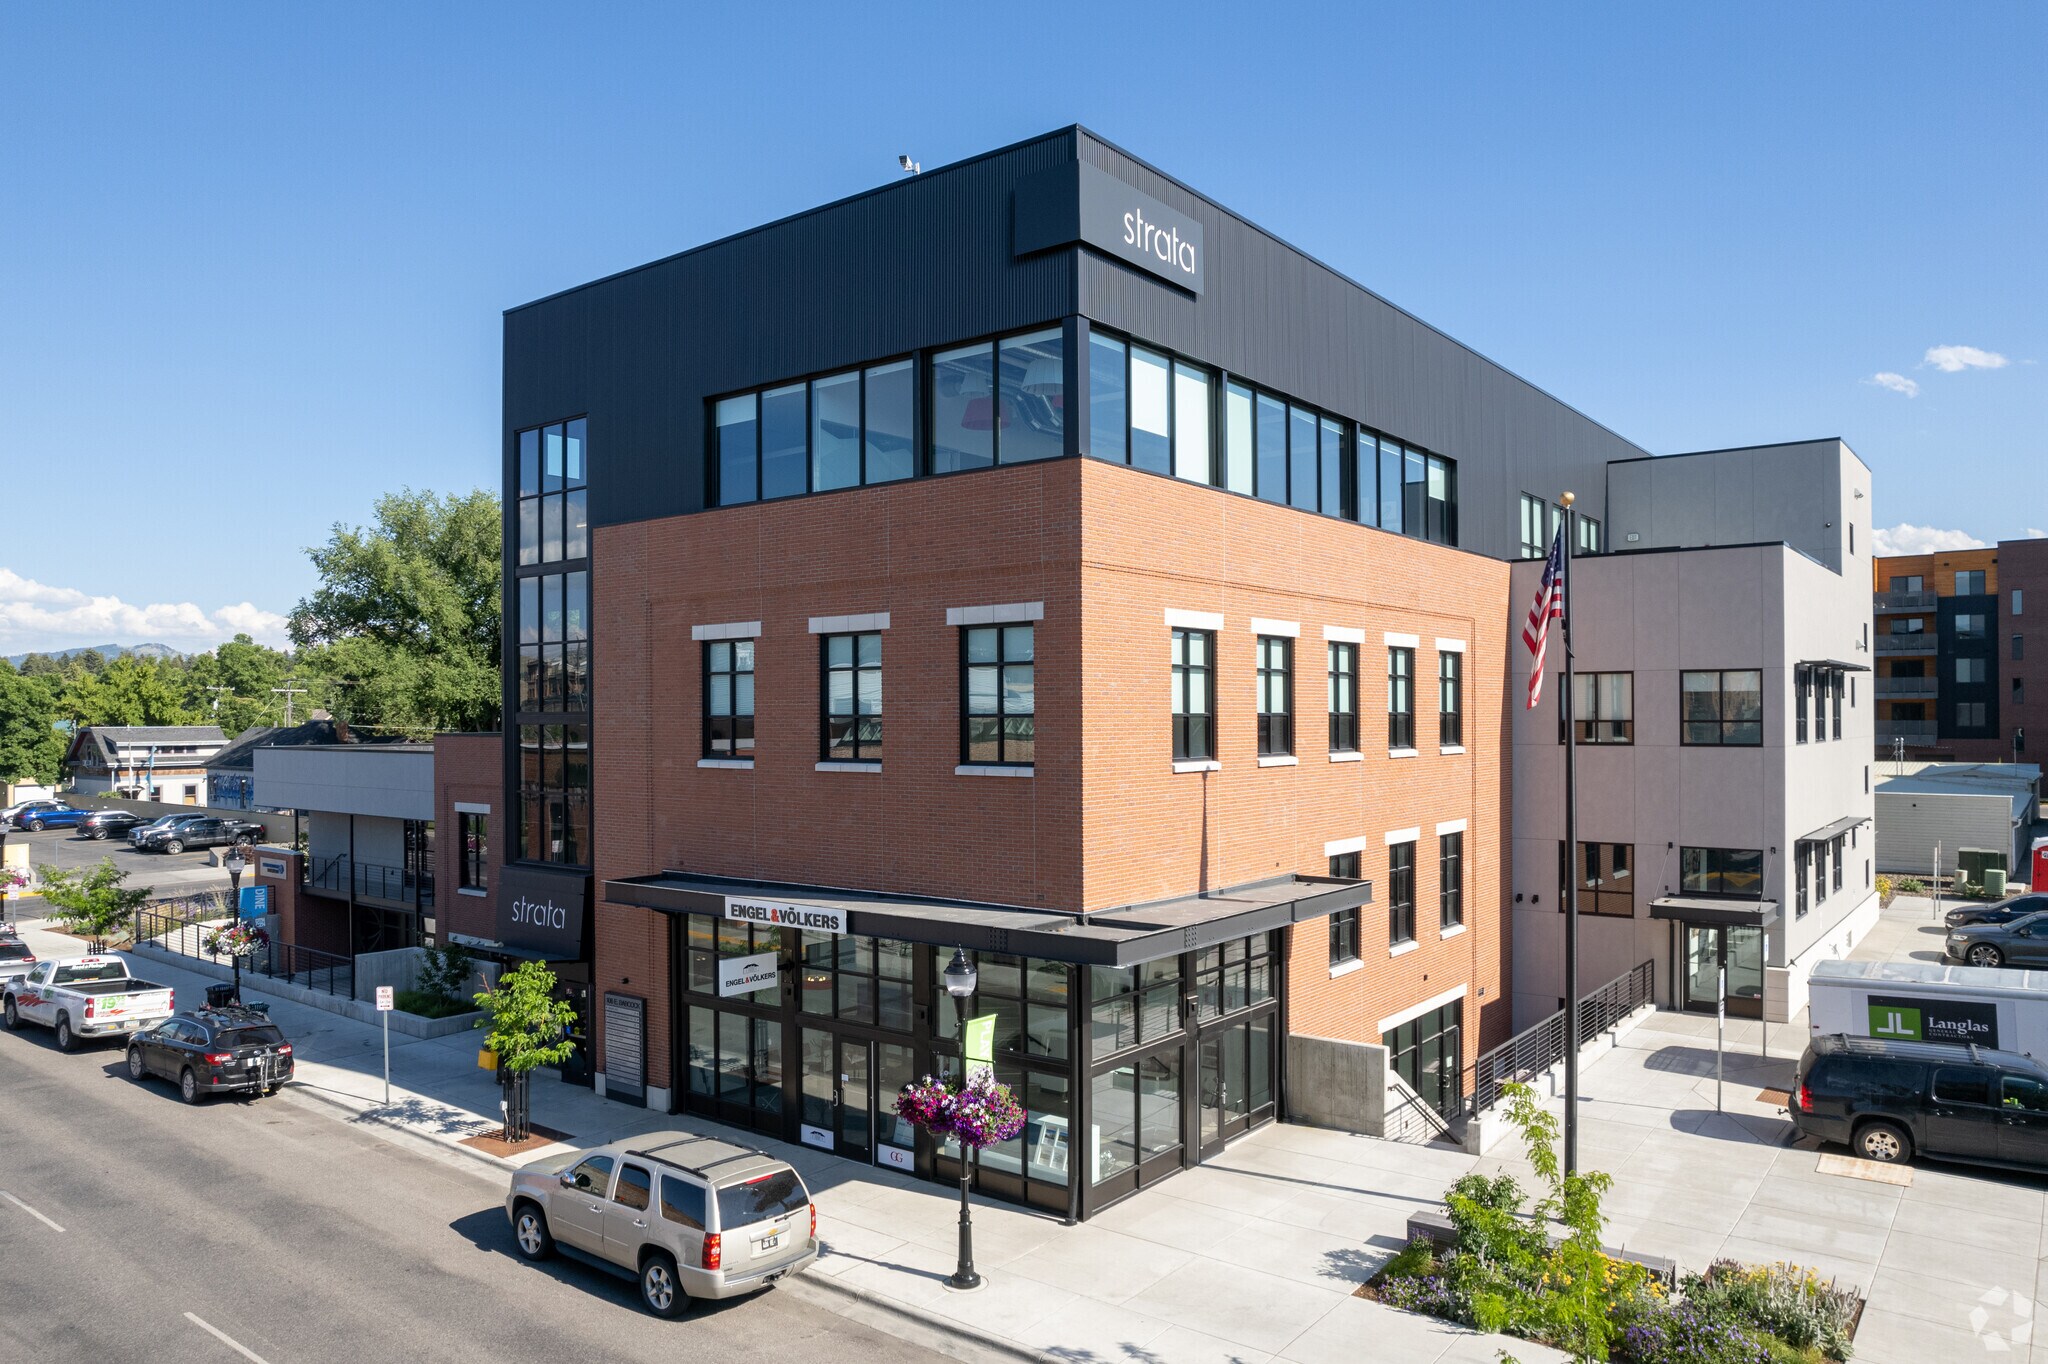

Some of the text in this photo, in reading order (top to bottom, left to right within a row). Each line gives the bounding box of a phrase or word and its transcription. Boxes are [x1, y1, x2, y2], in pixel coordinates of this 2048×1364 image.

[1124, 208, 1195, 274] strata
[254, 888, 266, 910] DINE
[511, 895, 566, 929] strata
[978, 1020, 993, 1058] PLAY
[1928, 1016, 1990, 1035] Langlas
